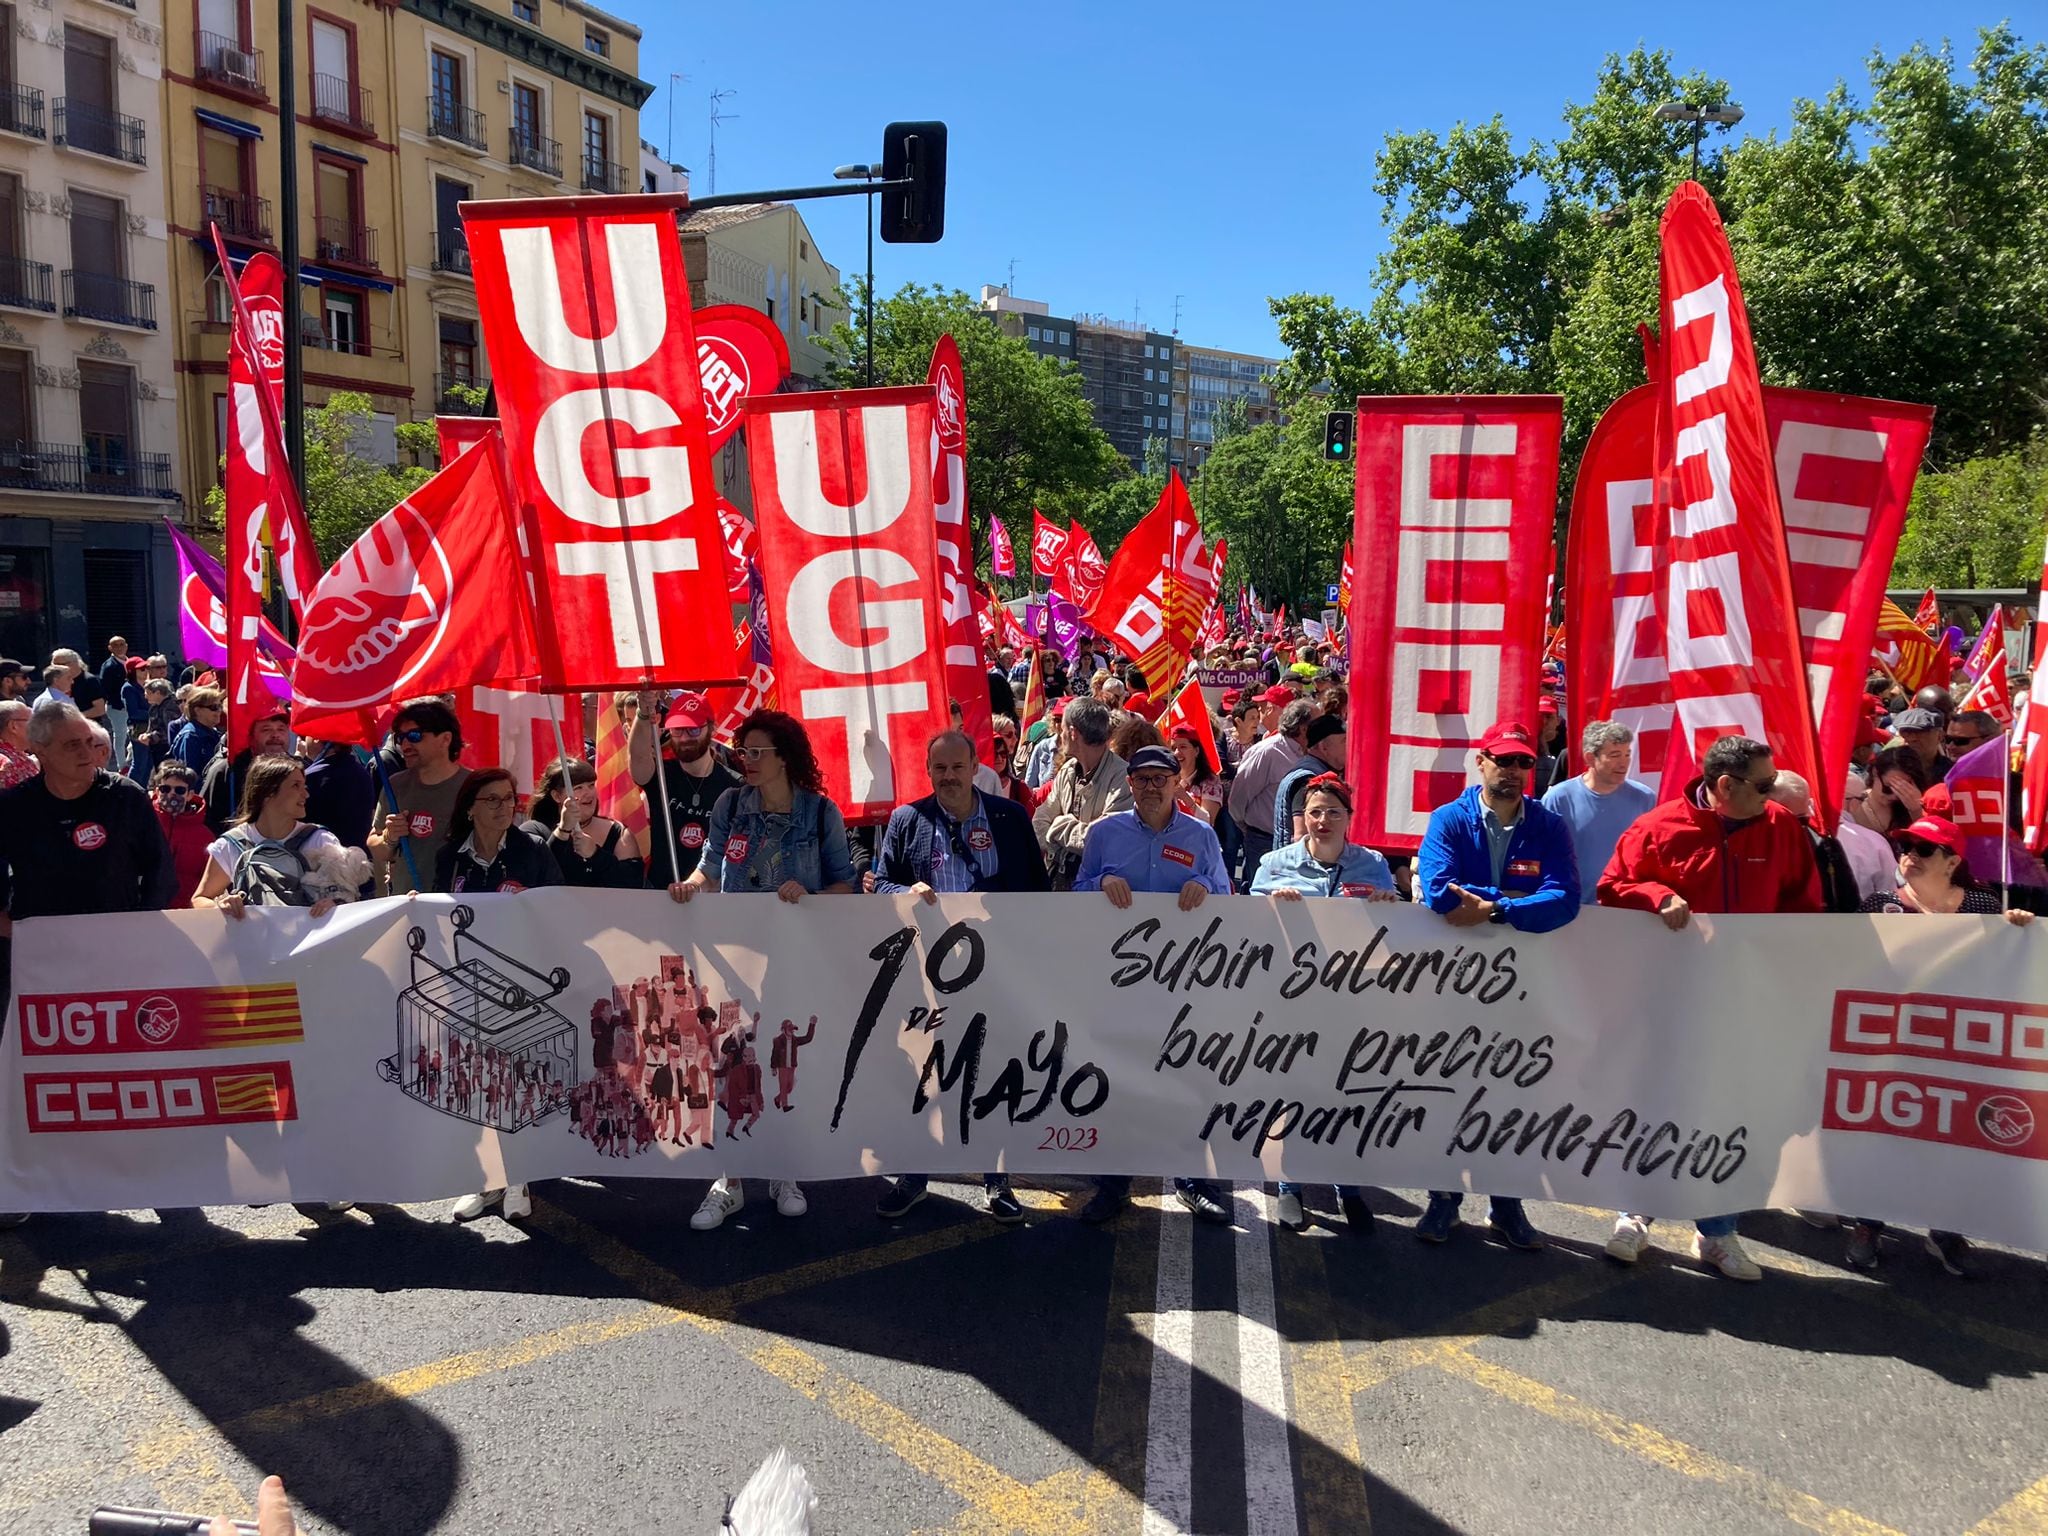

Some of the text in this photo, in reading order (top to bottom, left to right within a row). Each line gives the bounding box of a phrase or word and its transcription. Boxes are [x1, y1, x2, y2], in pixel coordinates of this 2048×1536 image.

[499, 222, 700, 669] UGT
[769, 404, 929, 804] UGT
[1329, 586, 1338, 600] P
[1199, 671, 1216, 684] We
[1217, 672, 1237, 684] Can
[1240, 672, 1254, 684] Do
[1163, 848, 1185, 860] CCOO
[1110, 916, 1272, 993] Subir
[26, 998, 129, 1048] UGT
[903, 1005, 949, 1033] DE
[1845, 1001, 2048, 1061] CCOO
[1153, 1002, 1555, 1092] bajar precios
[35, 1077, 205, 1123] CCOO
[1835, 1078, 1968, 1134] UGT
[1037, 1126, 1098, 1152] 2023
[1198, 1078, 1749, 1185] repartir beneficios
